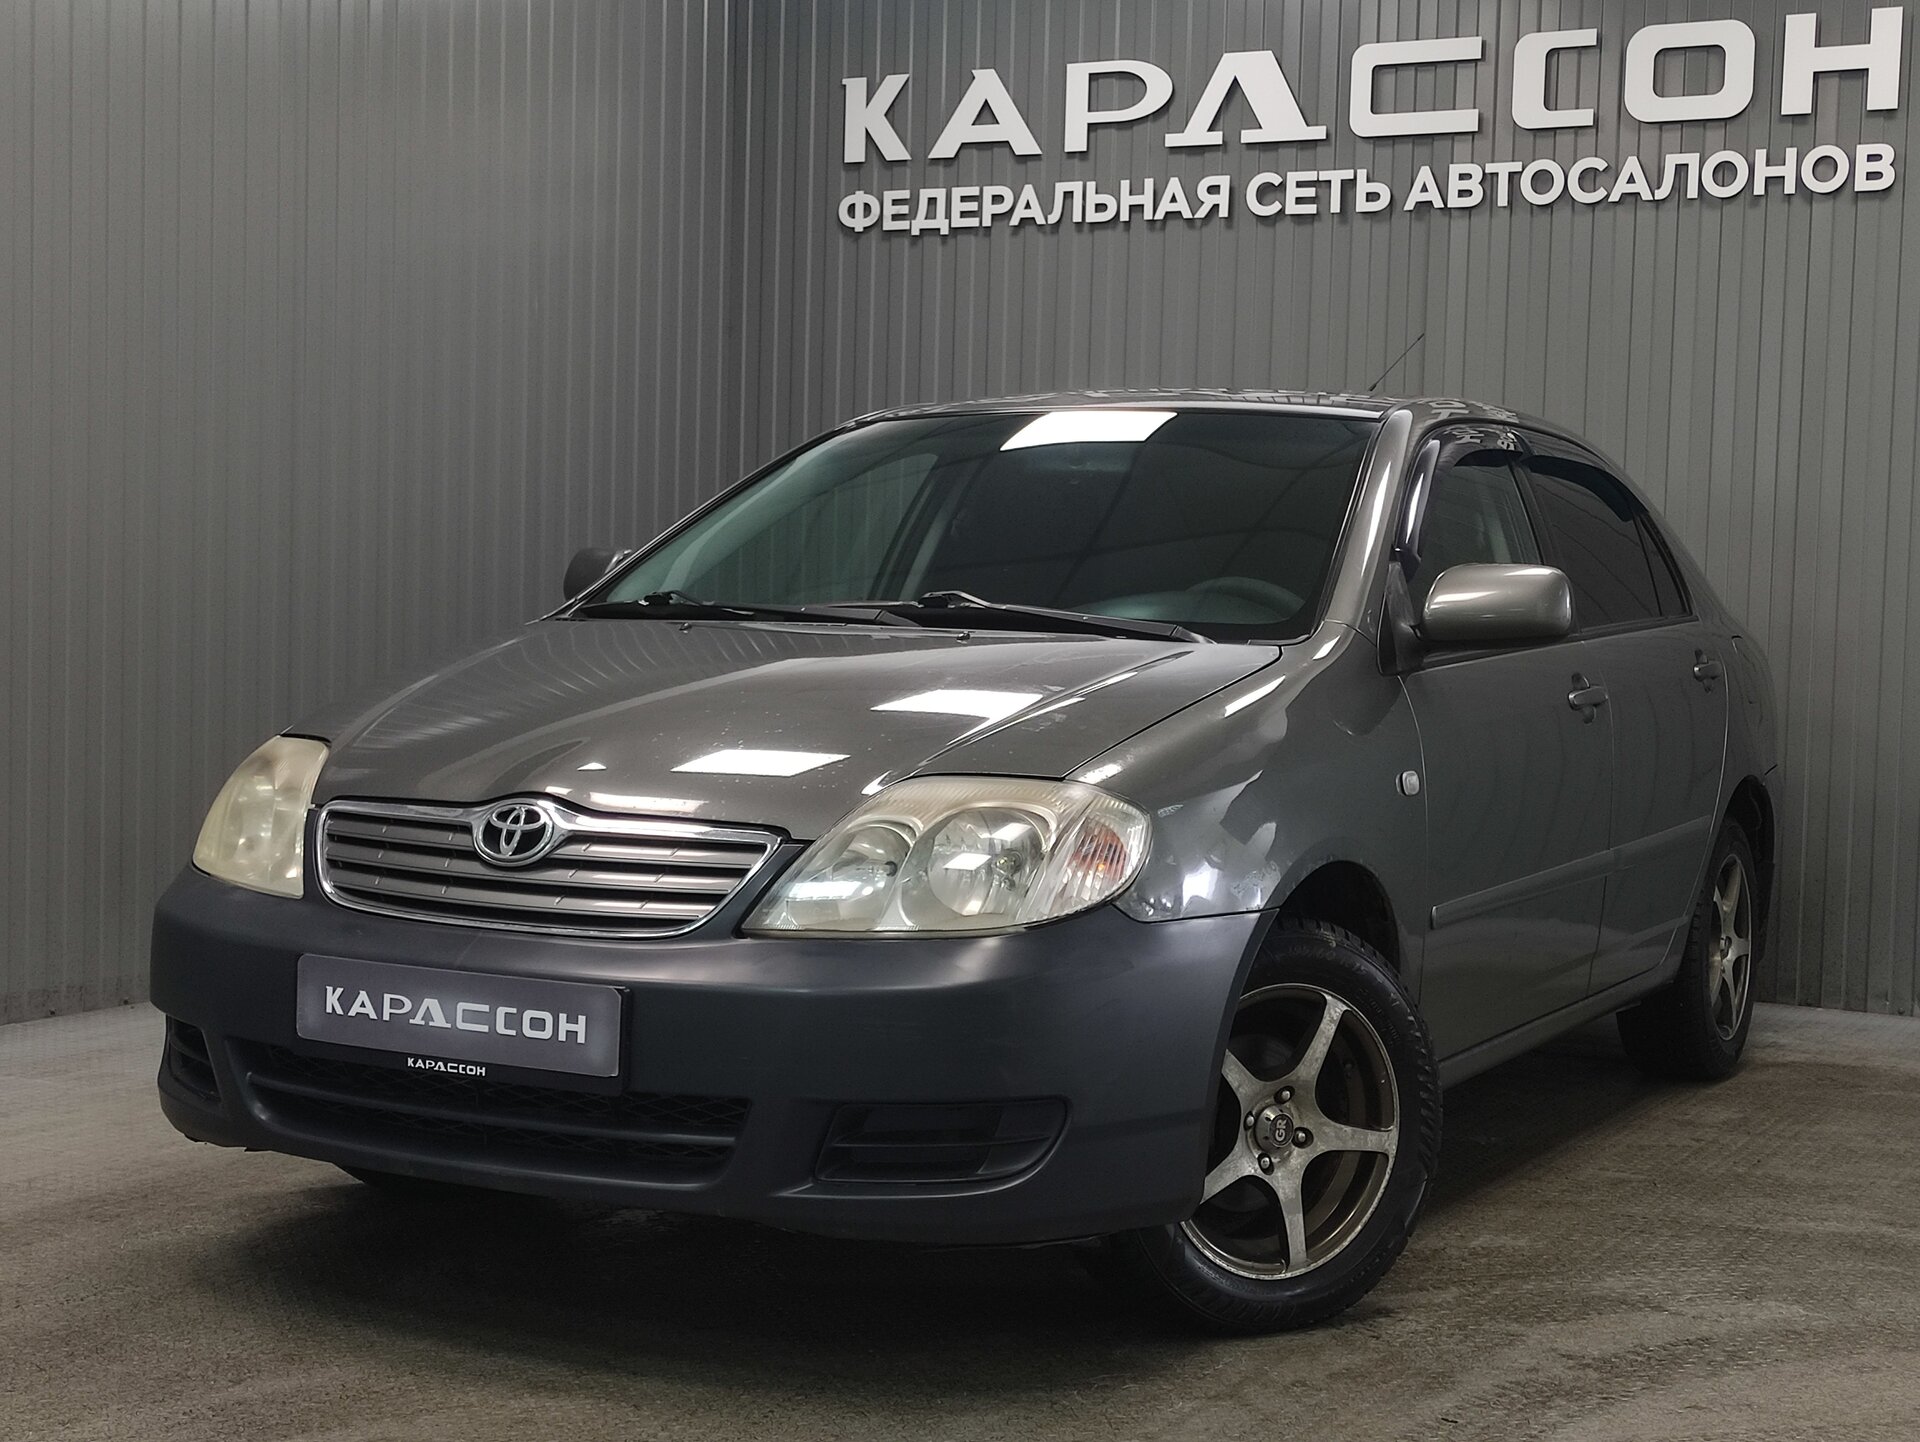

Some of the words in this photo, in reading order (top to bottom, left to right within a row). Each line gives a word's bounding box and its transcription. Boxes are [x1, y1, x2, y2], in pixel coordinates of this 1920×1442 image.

[837, 173, 1232, 237] ФЕДЕРАЛЬНАЯ
[1245, 166, 1392, 217] СЕТЬ
[1403, 143, 1897, 212] АВТОСАЛОНОВ
